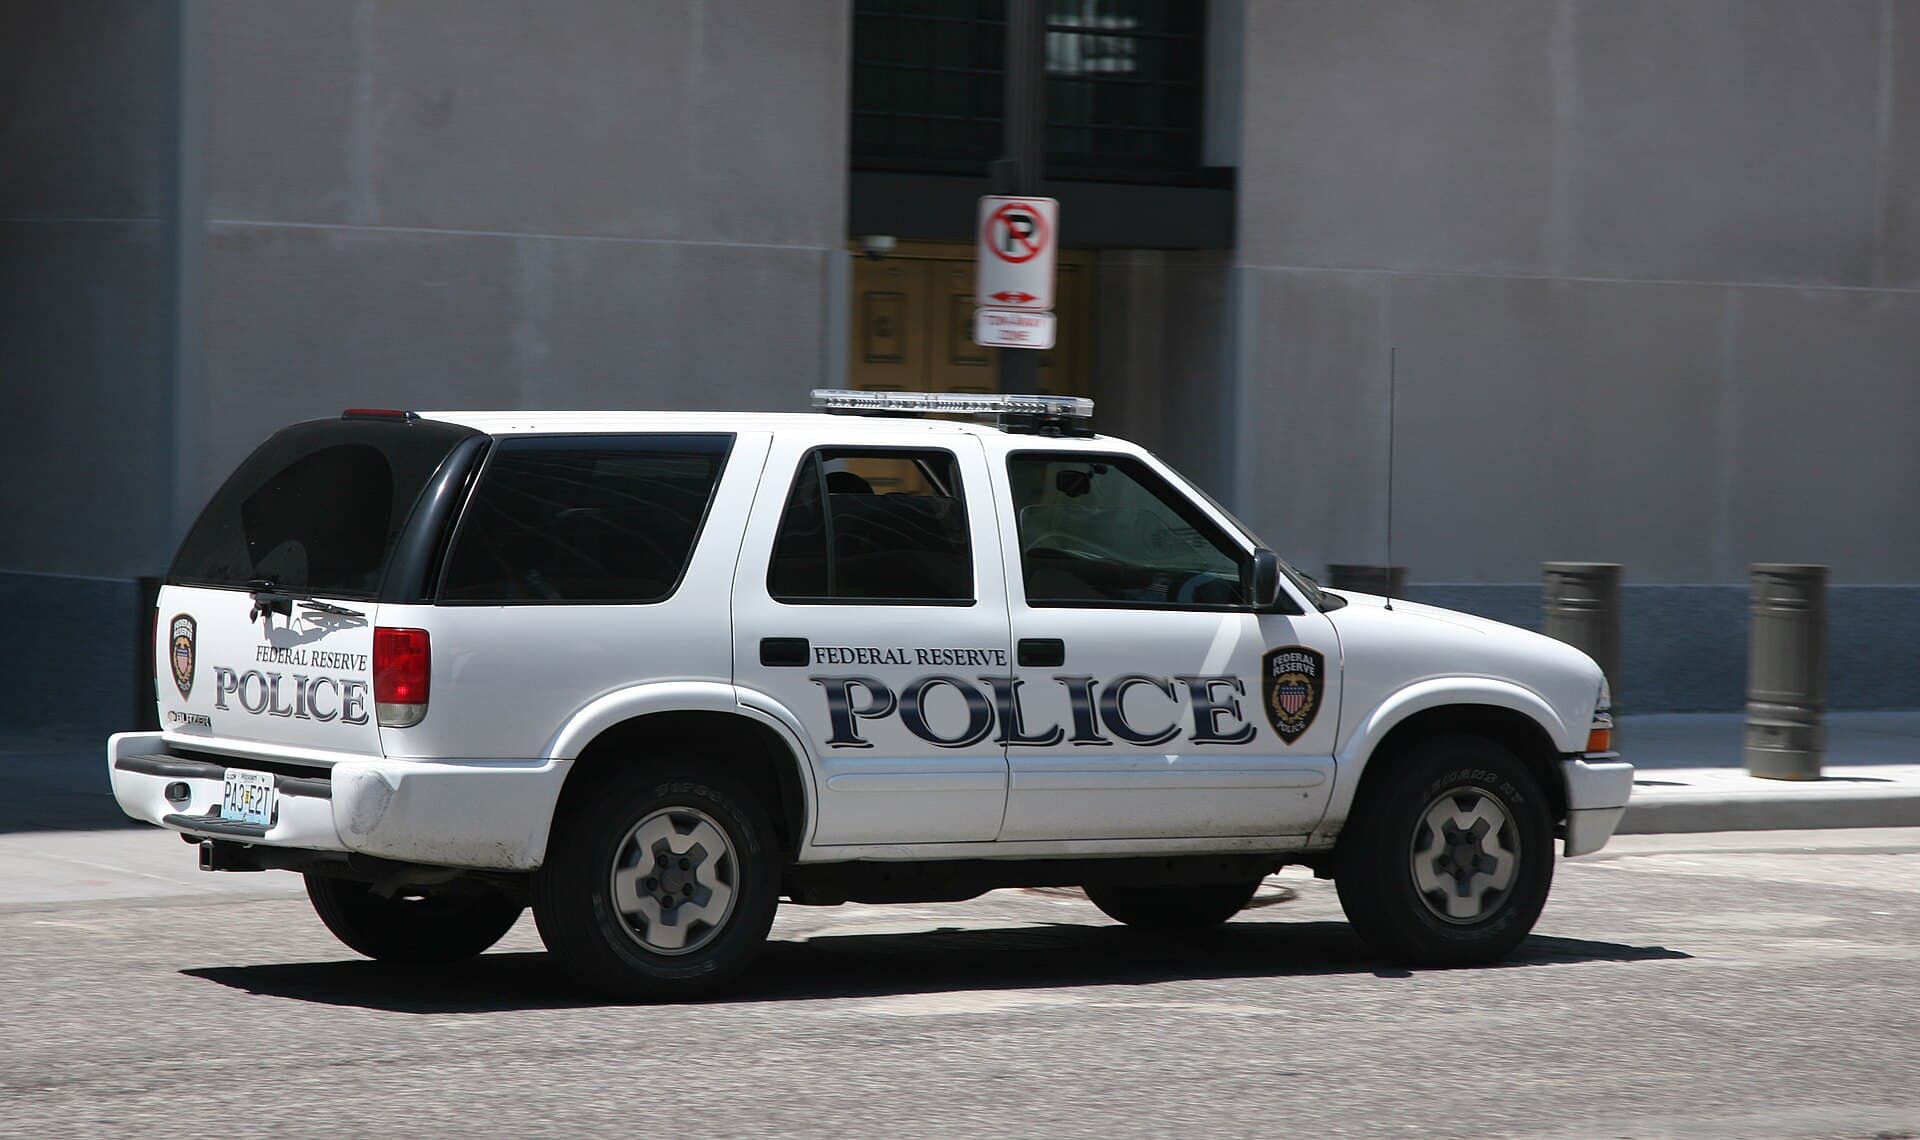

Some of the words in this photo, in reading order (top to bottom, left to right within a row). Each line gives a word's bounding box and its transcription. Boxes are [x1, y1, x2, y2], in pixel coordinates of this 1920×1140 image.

[256, 645, 308, 665] FEDERAL
[312, 651, 368, 671] RESERVE
[814, 646, 911, 665] FEDERAL
[914, 648, 1007, 667] RESERVE
[1272, 652, 1315, 667] FEDERAL
[1272, 662, 1315, 677] RESERVE
[213, 666, 370, 726] POLICE
[808, 673, 1257, 748] POLICE
